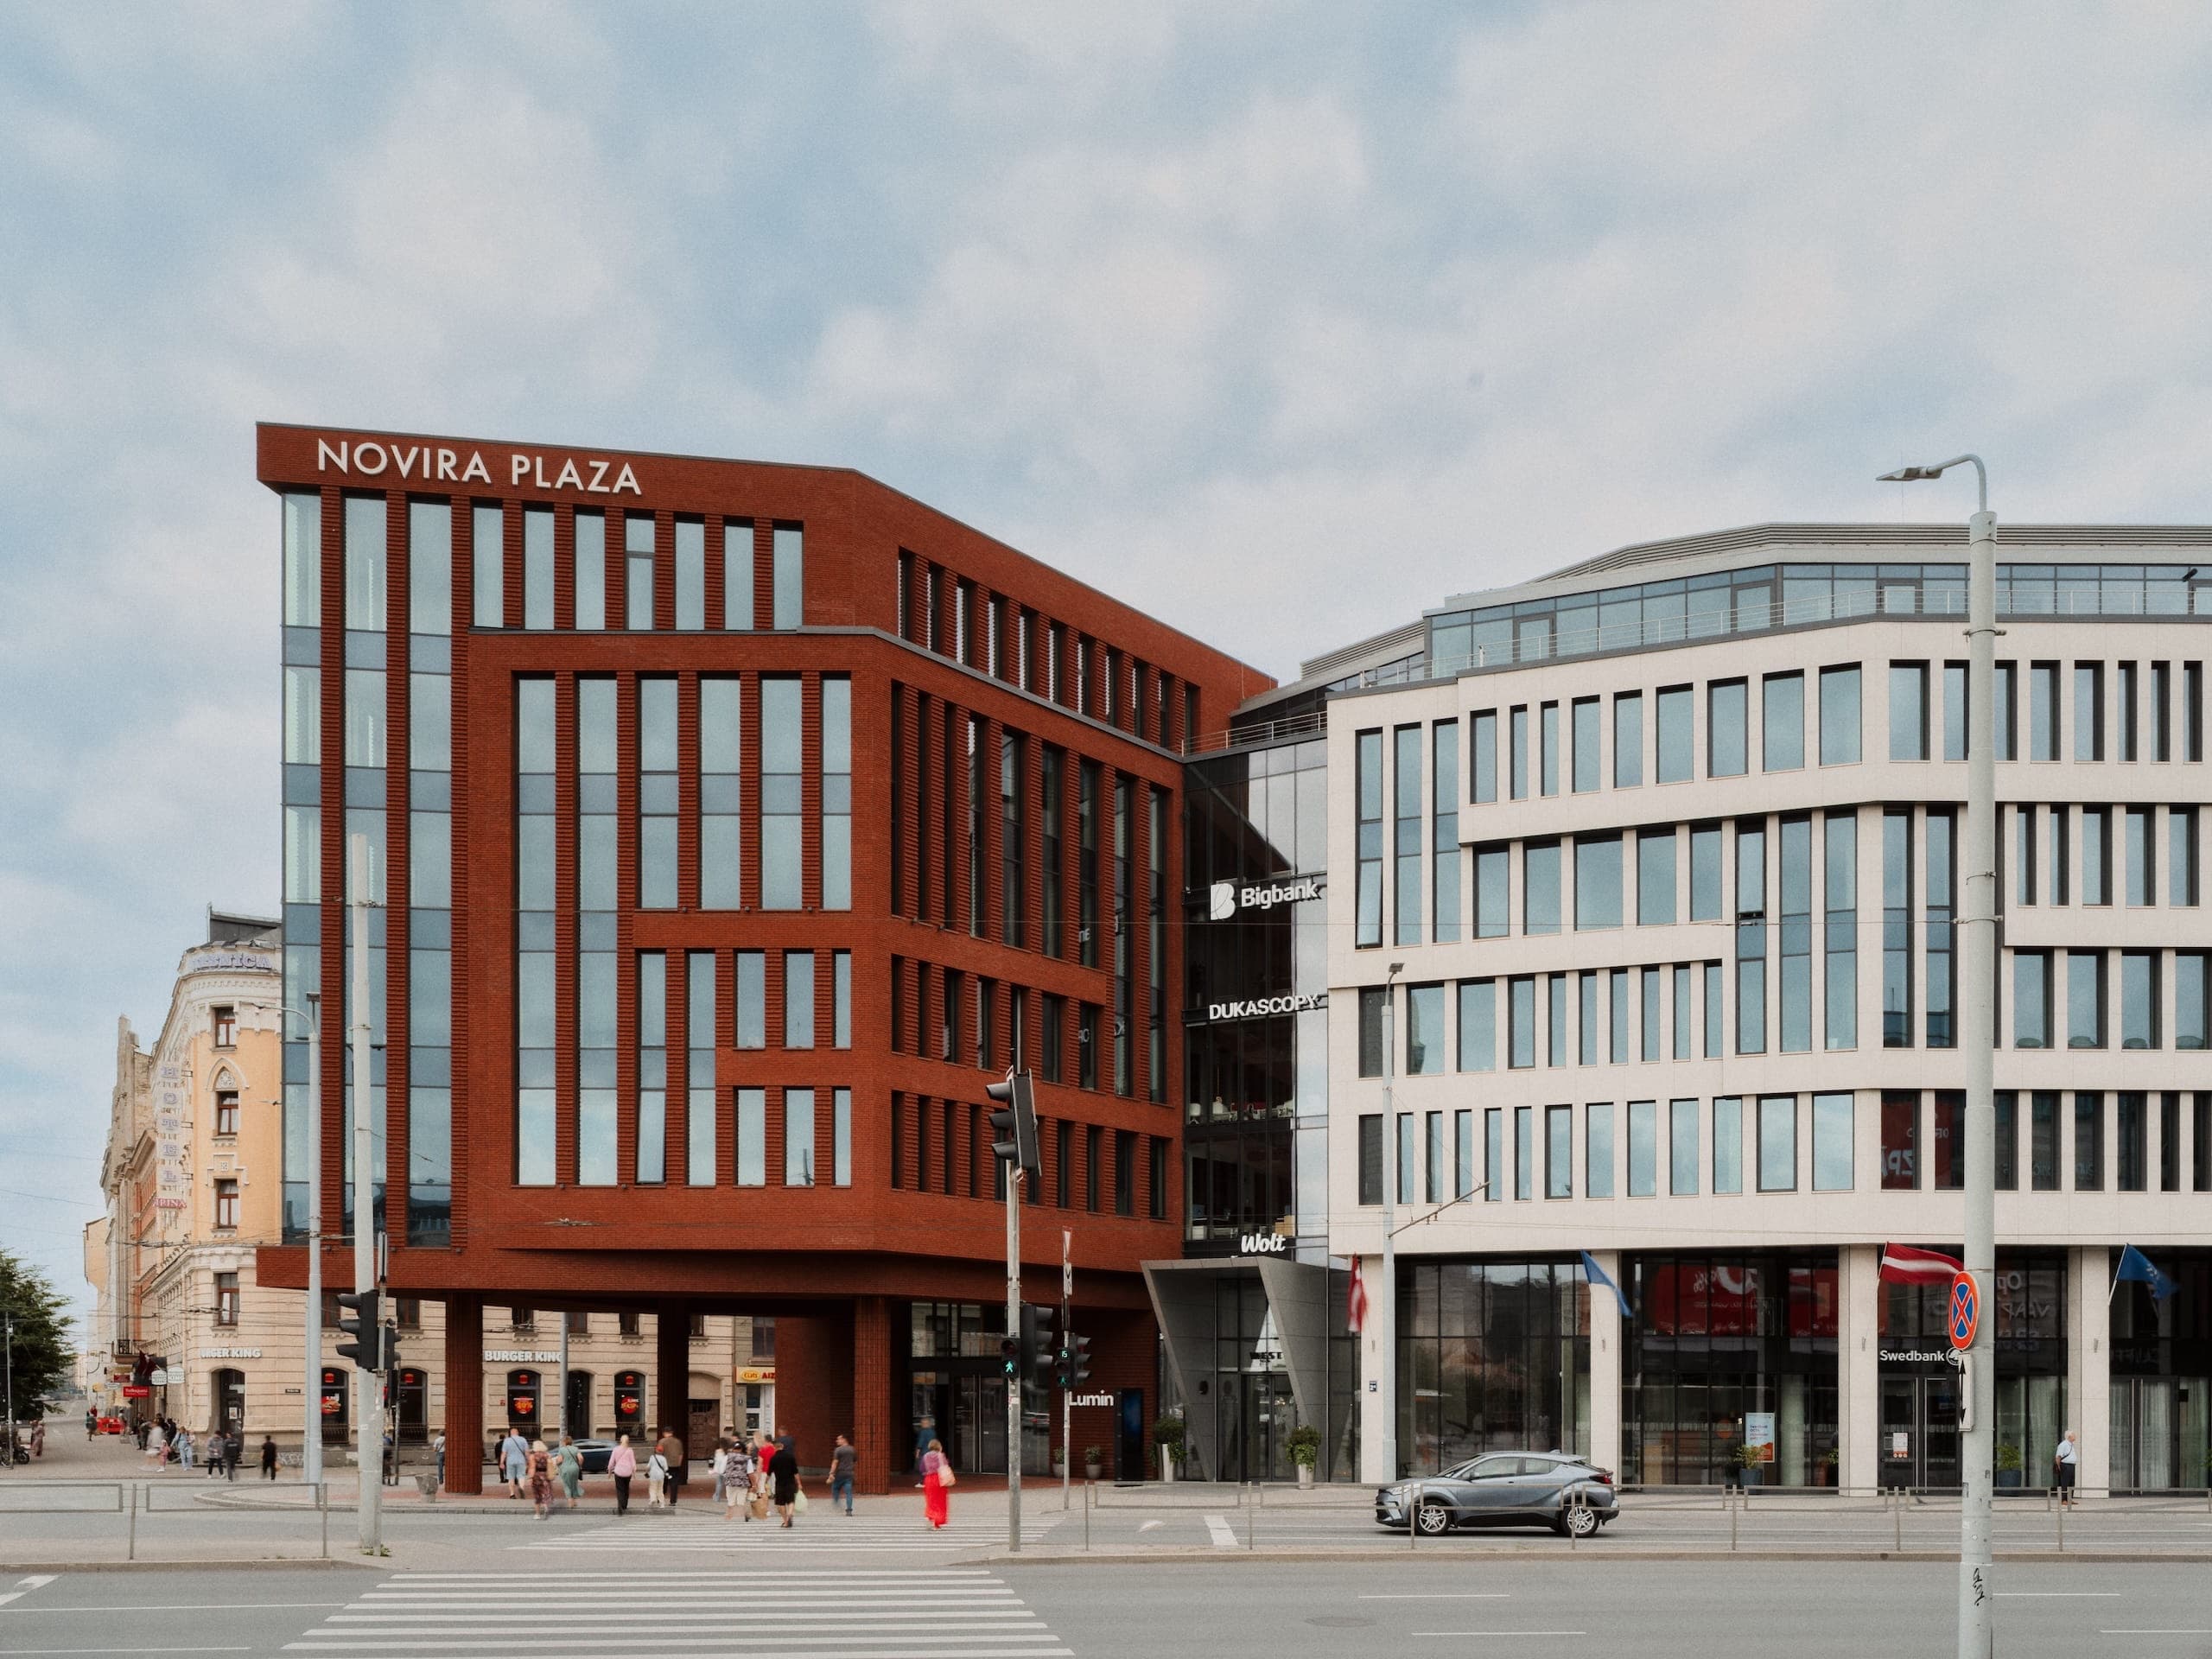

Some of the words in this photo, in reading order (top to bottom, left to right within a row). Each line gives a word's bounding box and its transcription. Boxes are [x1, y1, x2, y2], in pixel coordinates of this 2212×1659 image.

[318, 438, 492, 485] NOVIRA
[512, 454, 642, 496] PLAZA
[1241, 880, 1319, 910] Bigbank
[1209, 994, 1319, 1020] DUKASCOPY
[1241, 1232, 1287, 1253] Wolt
[232, 1348, 262, 1358] KING
[485, 1351, 533, 1363] BURGER
[1879, 1350, 1945, 1362] Swedbank
[1069, 1389, 1115, 1407] Lumin
